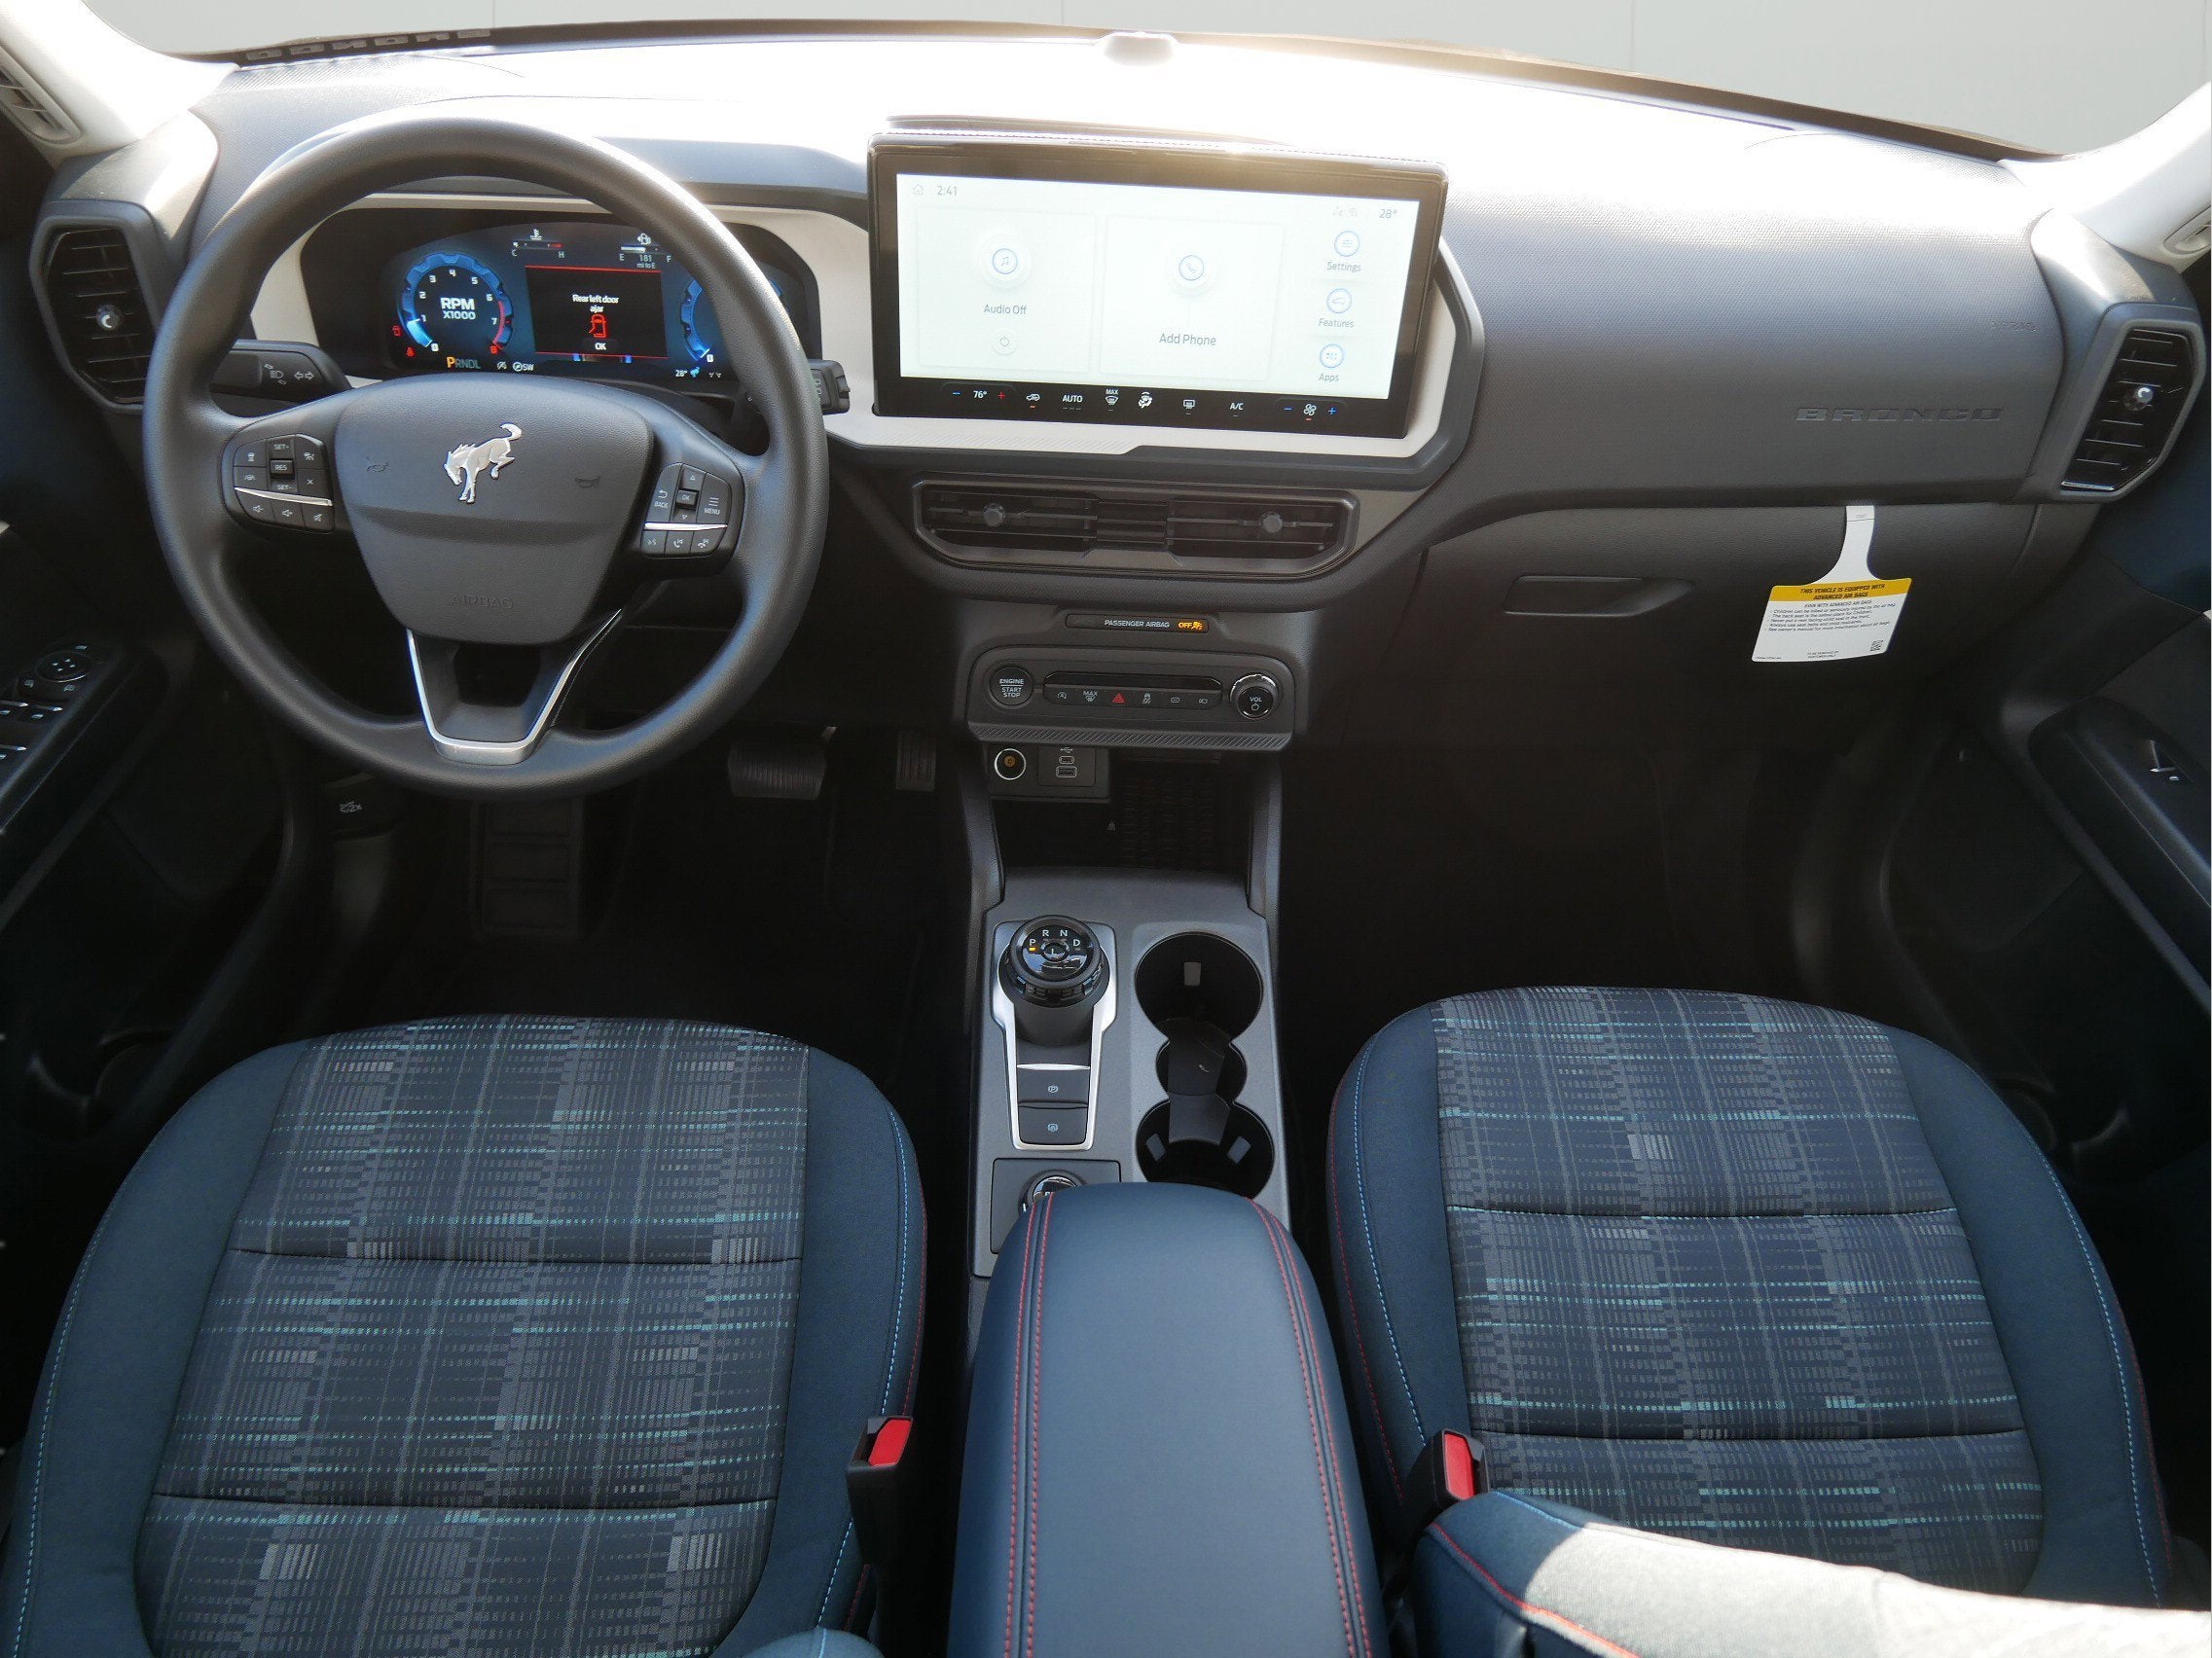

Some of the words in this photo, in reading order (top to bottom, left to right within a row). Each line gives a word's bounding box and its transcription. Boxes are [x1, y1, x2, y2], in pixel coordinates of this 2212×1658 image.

[936, 185, 958, 198] 2:41
[1326, 261, 1361, 272] Settings
[449, 269, 456, 277] 4
[429, 274, 437, 283] 3
[471, 276, 478, 285] 5
[440, 297, 476, 310] RPM
[572, 294, 589, 303] Rear
[983, 304, 1010, 314] Audio
[1012, 305, 1027, 314] Off
[1318, 317, 1355, 328] Features
[1159, 333, 1180, 344] Add
[1182, 334, 1216, 345] Phone
[1319, 372, 1339, 383] Apps
[973, 389, 987, 399] 76°
[1063, 394, 1083, 403] AUTO
[1230, 402, 1244, 411] A/C
[1795, 408, 2002, 421] BRONCO
[704, 507, 720, 516] MENU
[1105, 619, 1143, 629] PASSENGER
[1145, 620, 1170, 629] AIRBAG
[1178, 621, 1192, 630] OFF
